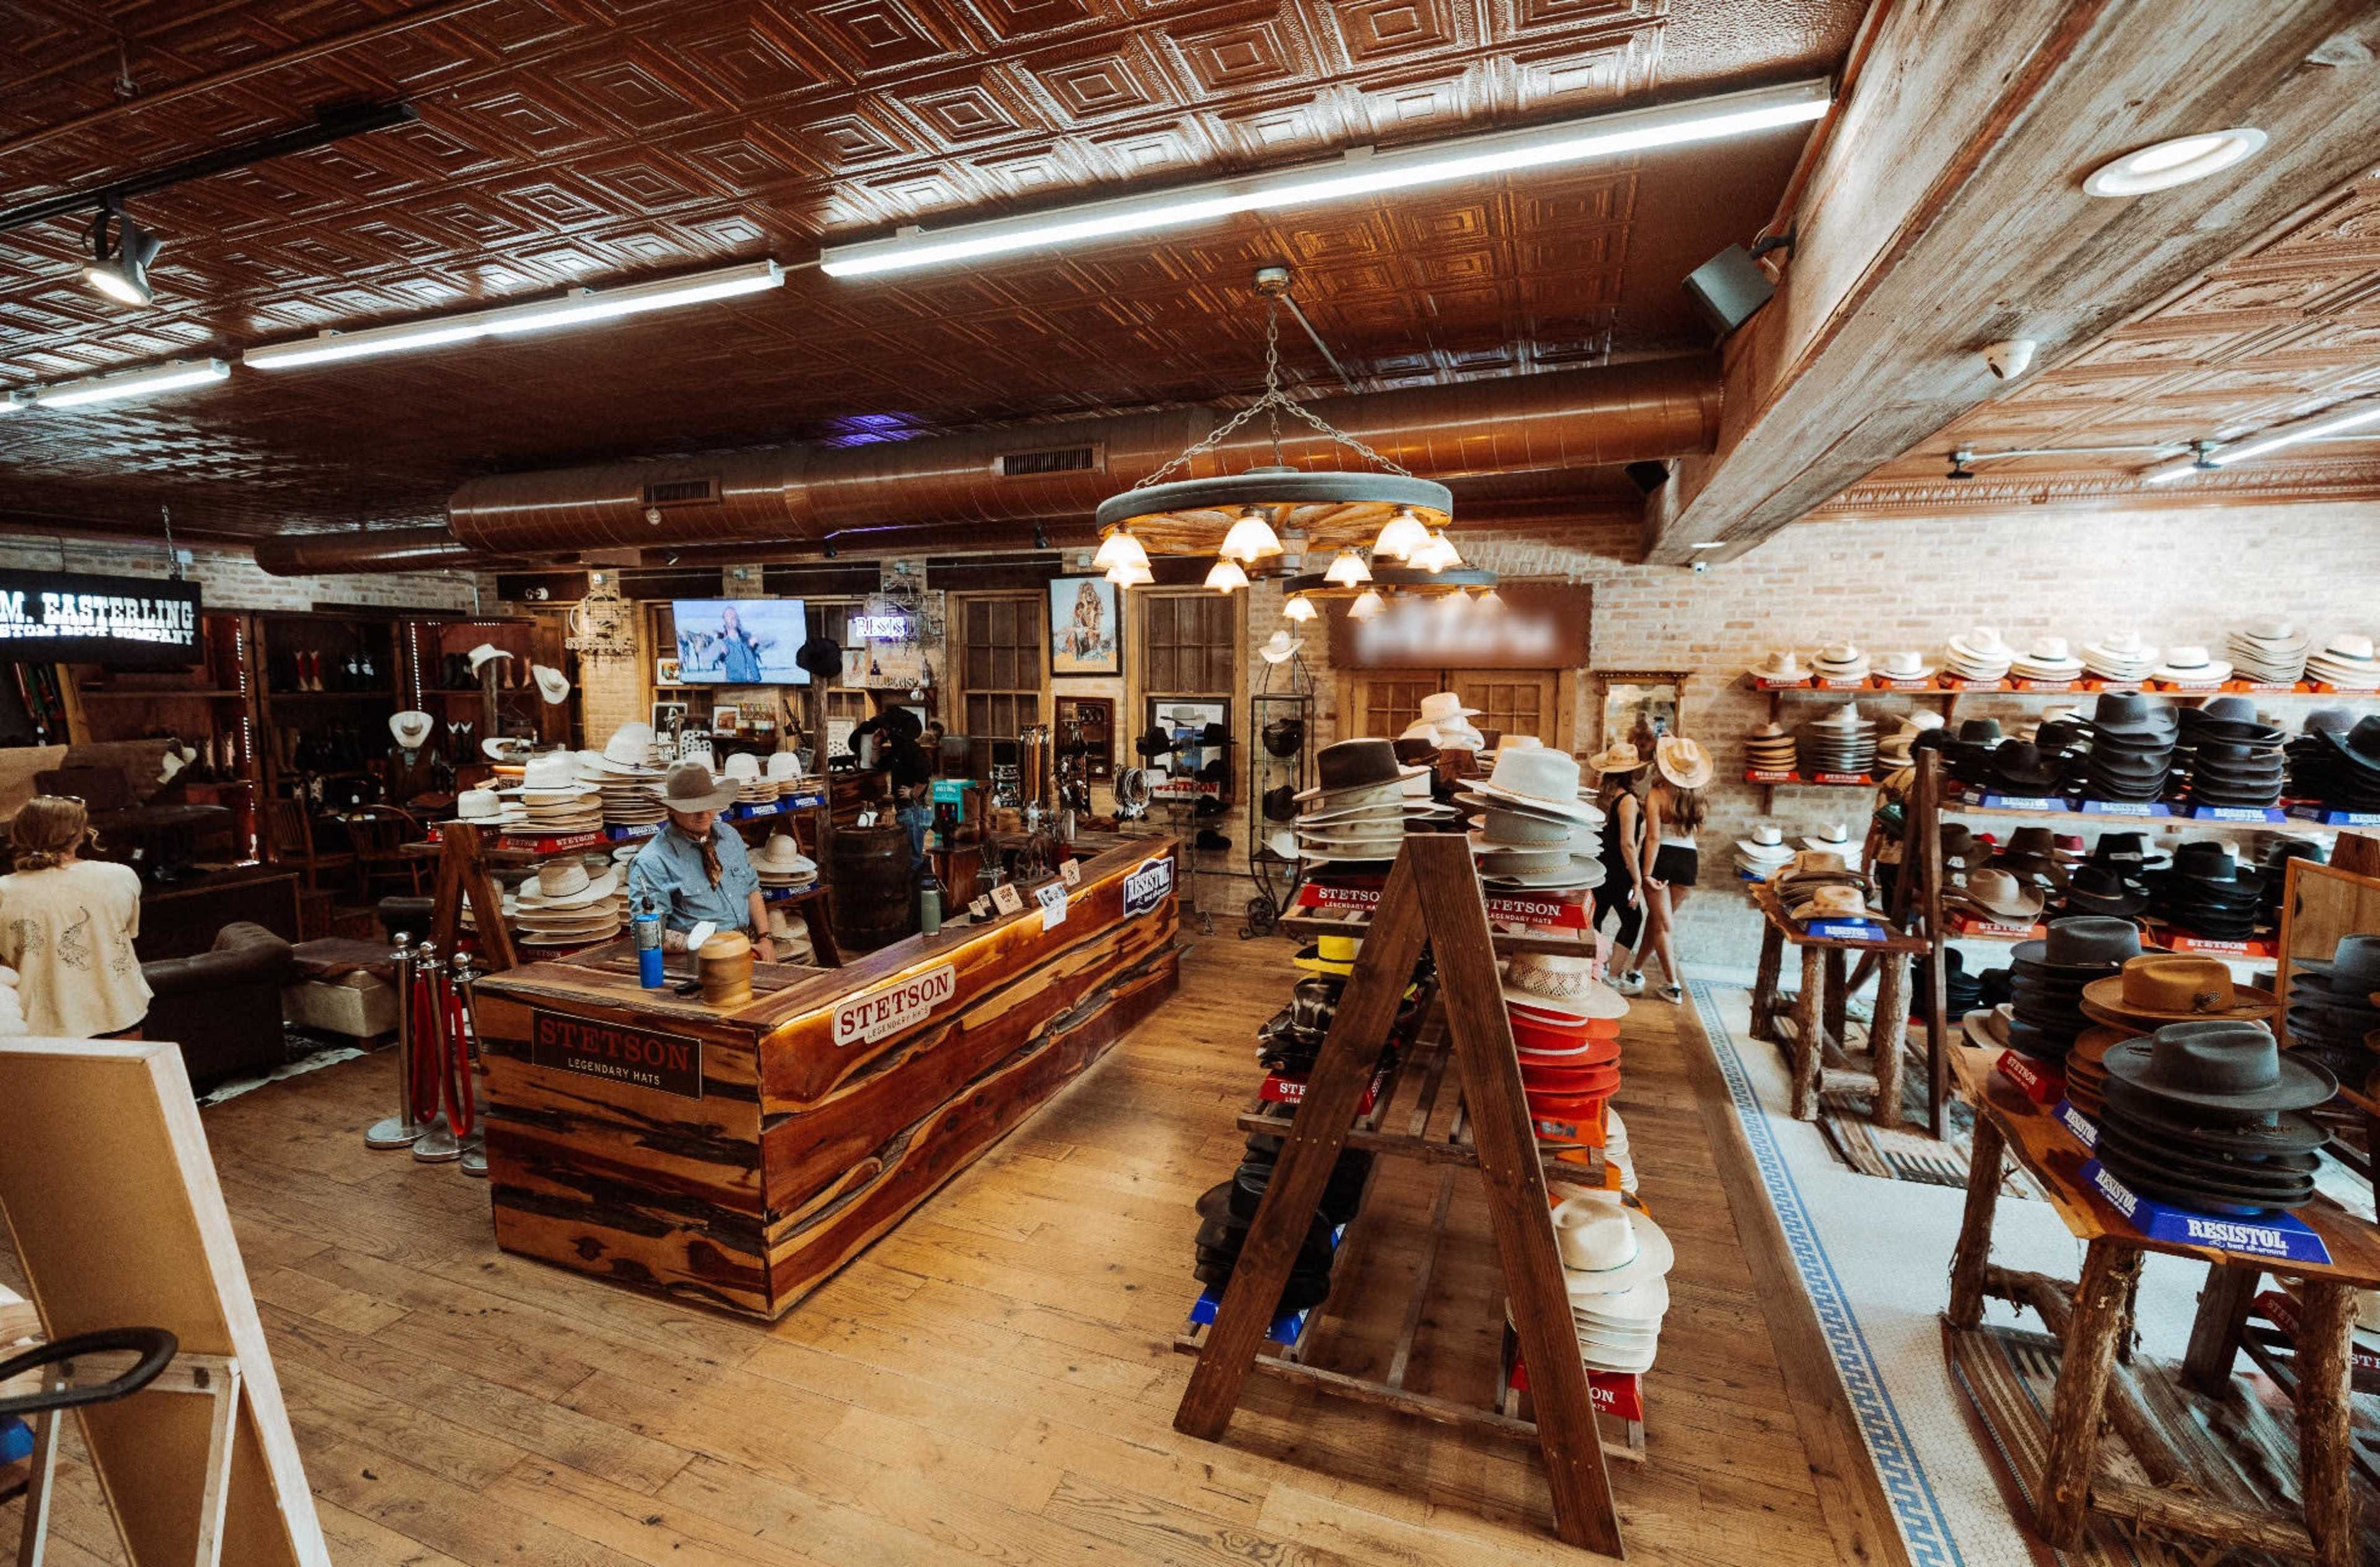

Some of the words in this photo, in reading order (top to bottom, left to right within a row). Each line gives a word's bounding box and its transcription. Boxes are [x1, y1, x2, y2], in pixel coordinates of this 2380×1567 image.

[42, 592, 194, 630] EASTERLING
[0, 623, 58, 638] STOM
[112, 626, 194, 645] COMPANY
[556, 833, 596, 845] STETSON
[1319, 888, 1382, 902] STETSO
[2187, 939, 2248, 950] STETSON
[841, 972, 948, 1037] STETSON
[867, 1014, 910, 1039] LEGENDARY
[540, 1017, 689, 1071] STETSON
[568, 1058, 629, 1078] LEGENDARY
[633, 1071, 660, 1085] HATS
[2007, 1056, 2038, 1085] STETSON
[2064, 1107, 2098, 1143] RESISTOL
[2095, 1167, 2138, 1214] RESISTOL
[2187, 1219, 2286, 1249] RESISTOL
